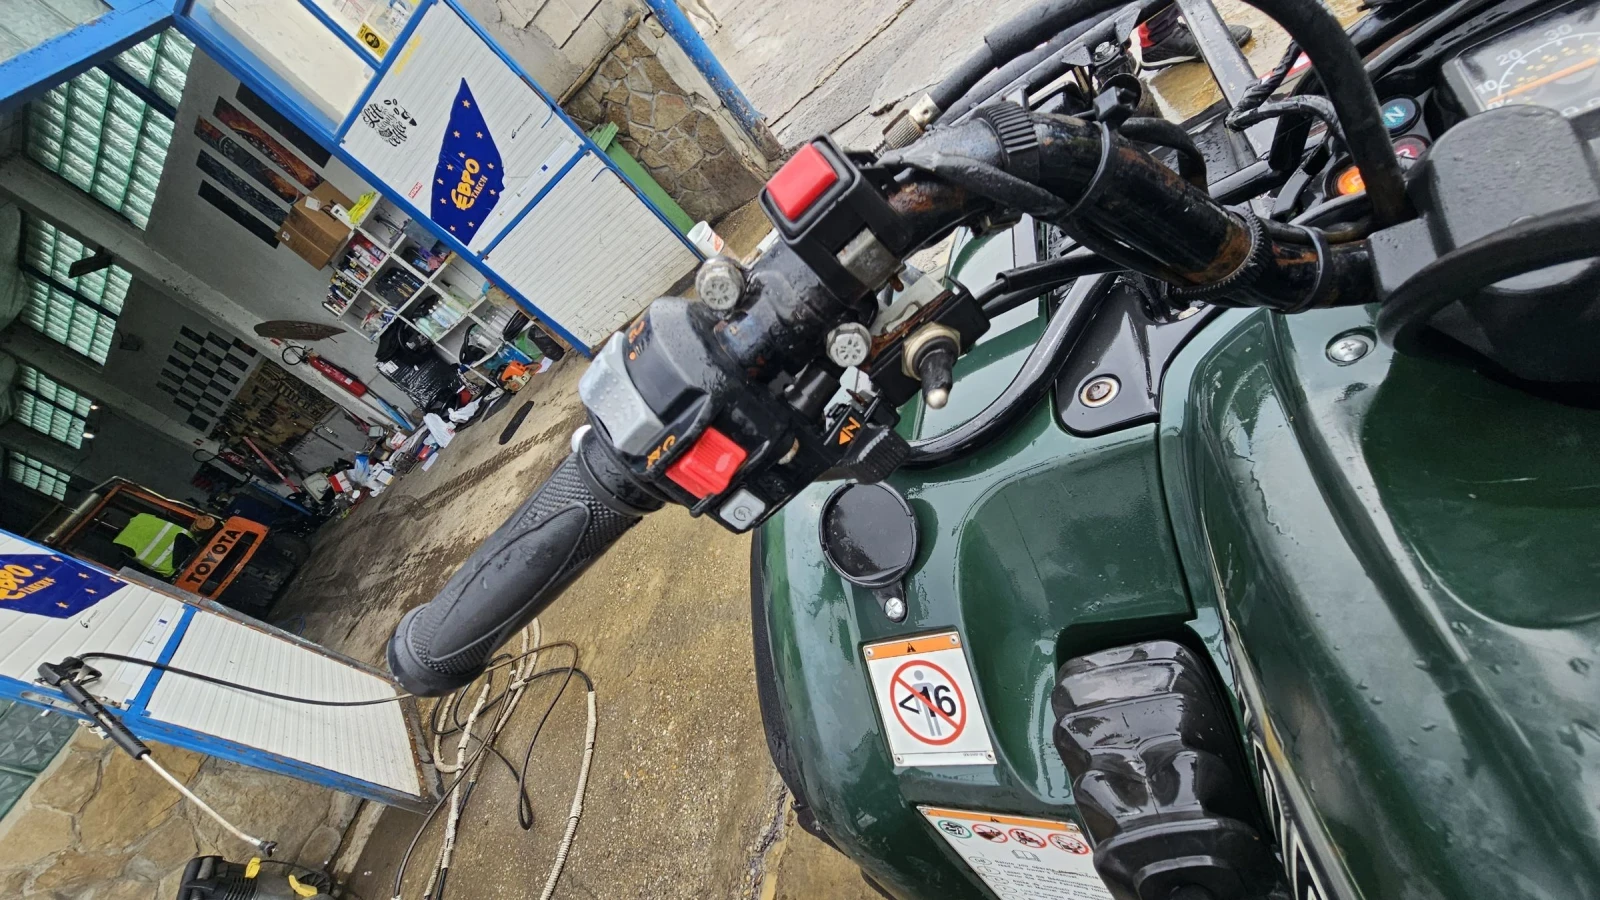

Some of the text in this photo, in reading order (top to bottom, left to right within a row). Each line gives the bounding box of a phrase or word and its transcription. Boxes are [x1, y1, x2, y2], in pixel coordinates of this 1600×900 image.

[1544, 24, 1573, 41] 30
[1496, 48, 1523, 67] 20
[1475, 79, 1498, 95] 10
[1384, 106, 1405, 123] N
[185, 529, 242, 585] TOYOTA
